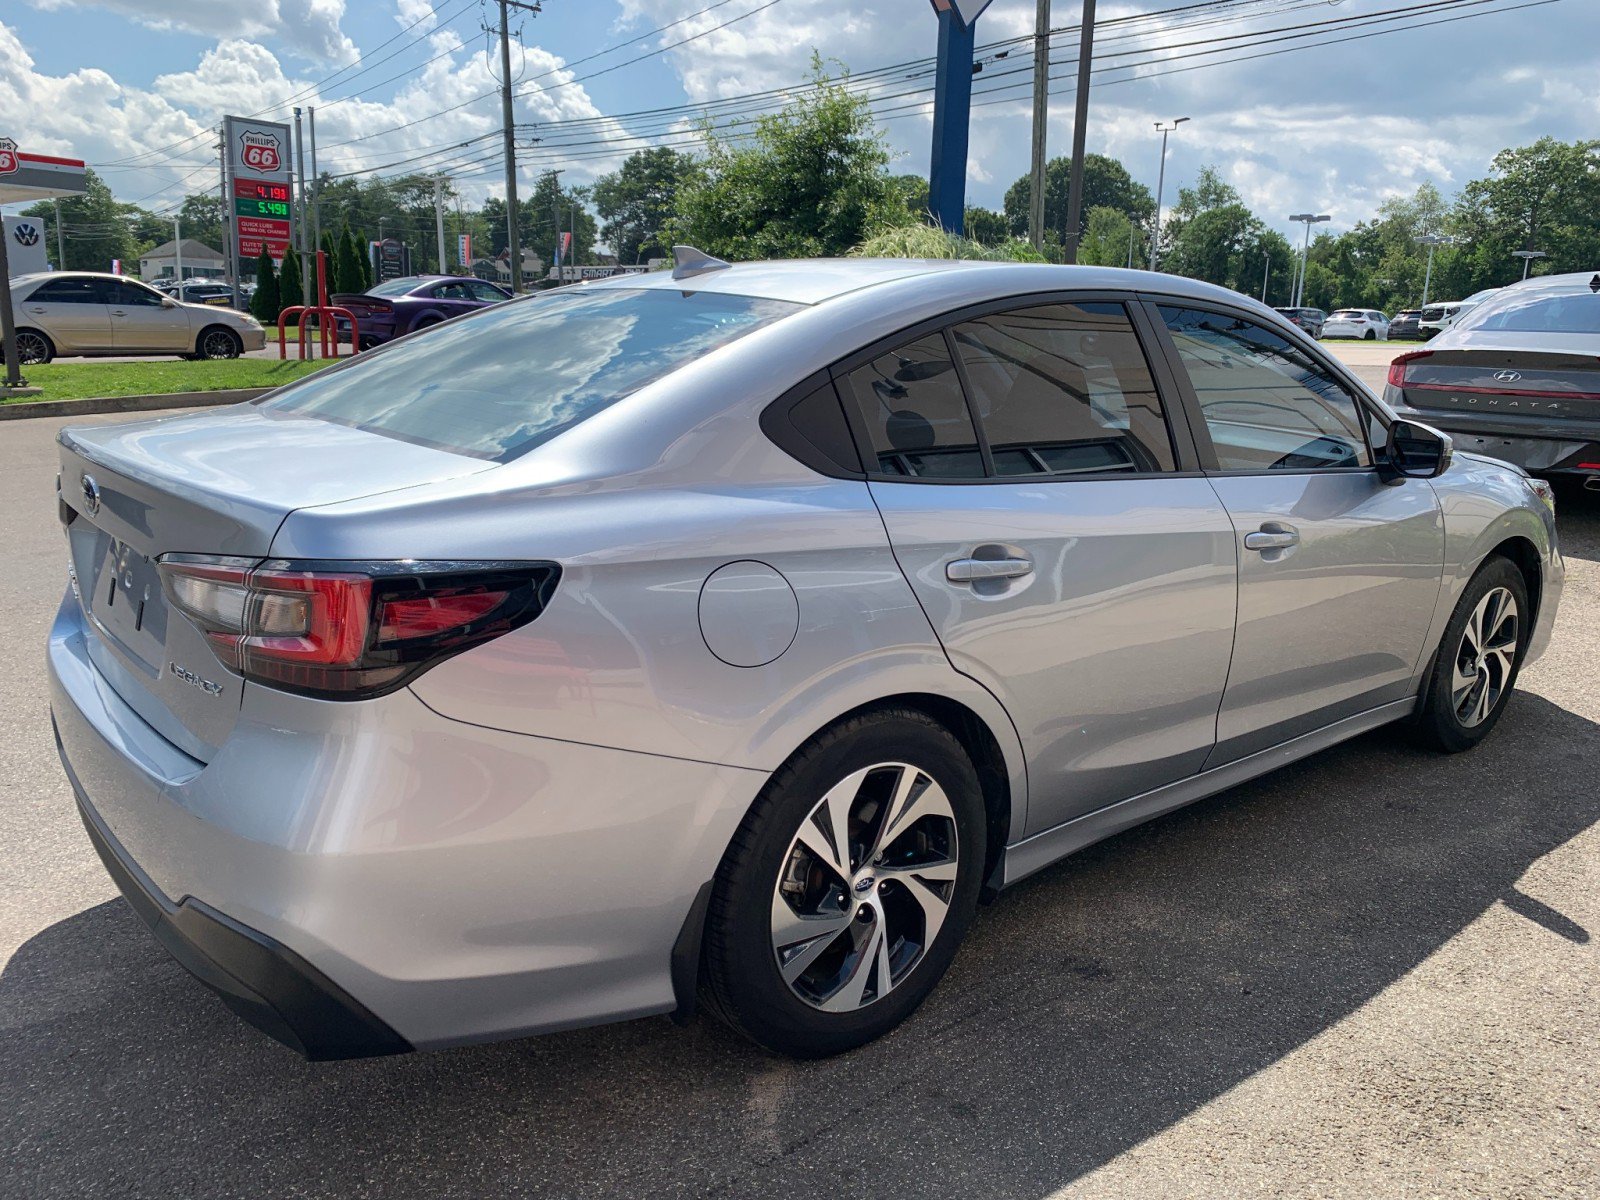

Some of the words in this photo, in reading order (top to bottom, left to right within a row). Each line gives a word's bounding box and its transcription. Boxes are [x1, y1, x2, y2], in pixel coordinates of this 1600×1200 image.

[245, 136, 275, 147] PHILLIPS
[248, 148, 274, 166] 66
[582, 269, 615, 278] SMART
[1450, 397, 1560, 409] SONATA
[169, 661, 224, 697] LEGACY
